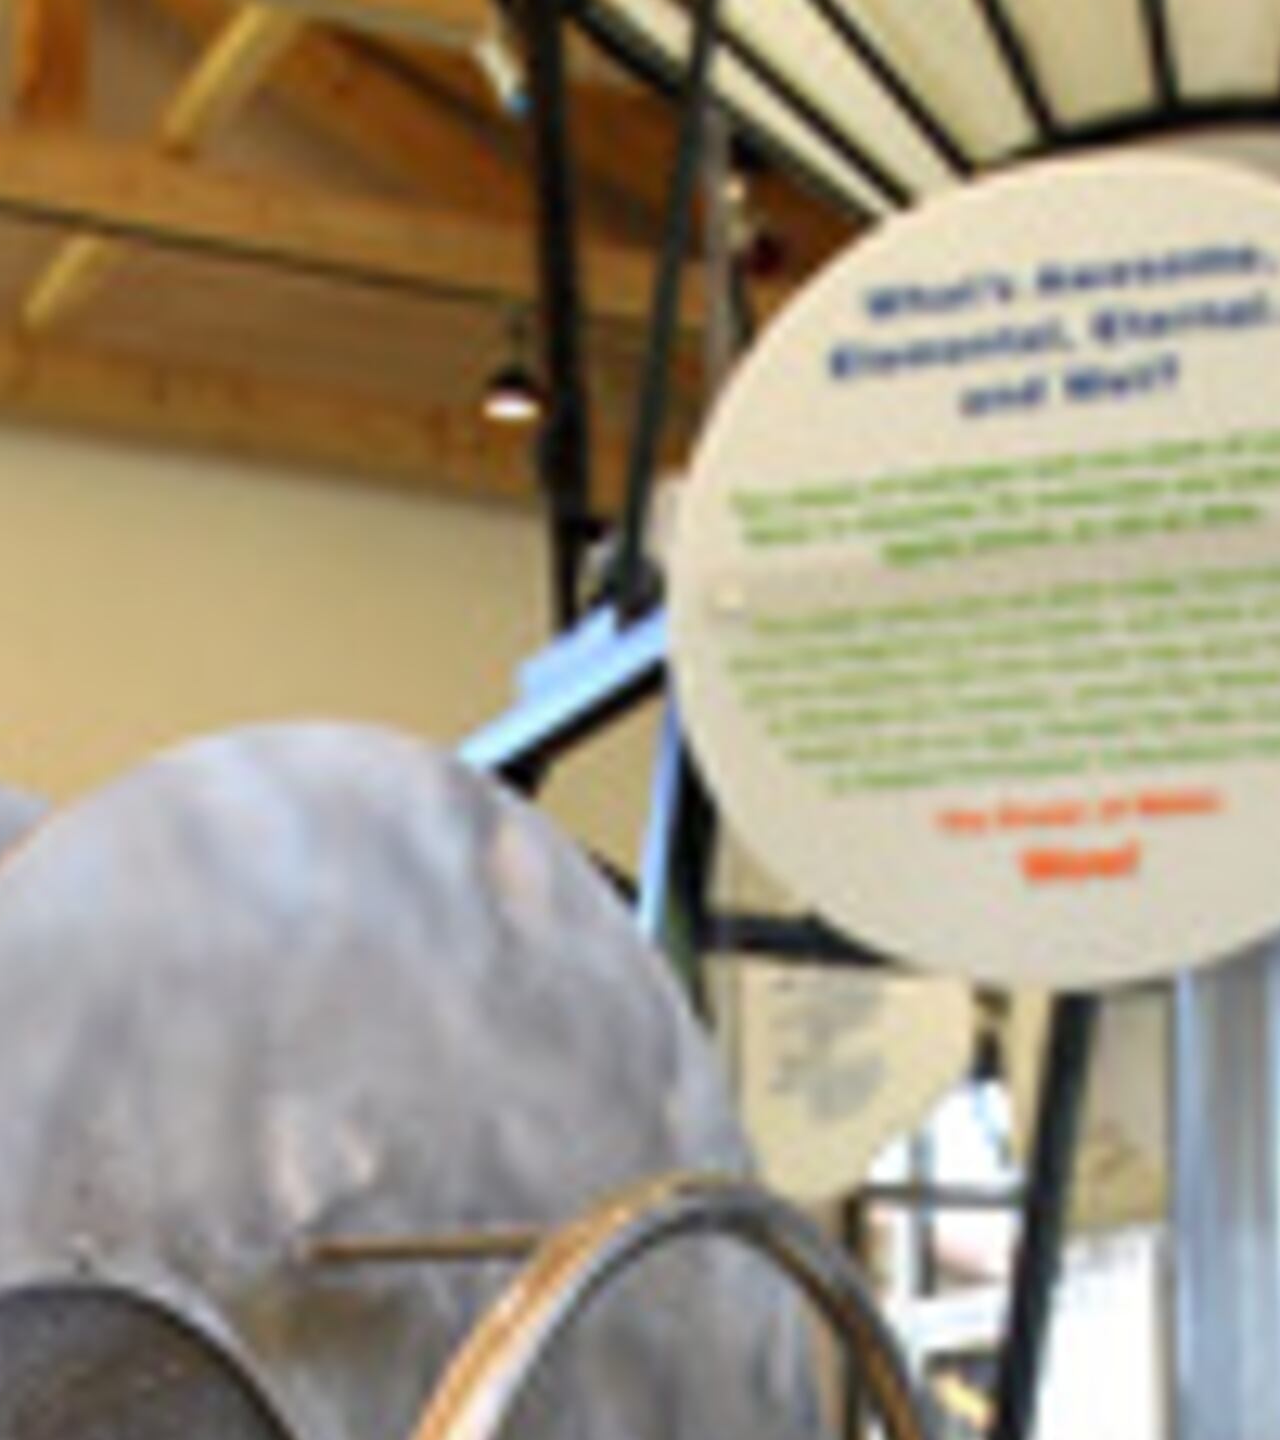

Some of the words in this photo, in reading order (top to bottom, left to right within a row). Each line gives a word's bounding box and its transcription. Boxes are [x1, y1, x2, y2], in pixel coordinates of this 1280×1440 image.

[865, 270, 1015, 320] What's
[1034, 244, 1280, 296] Awesome,
[827, 318, 1076, 381] Elemental,
[960, 374, 1047, 417] and
